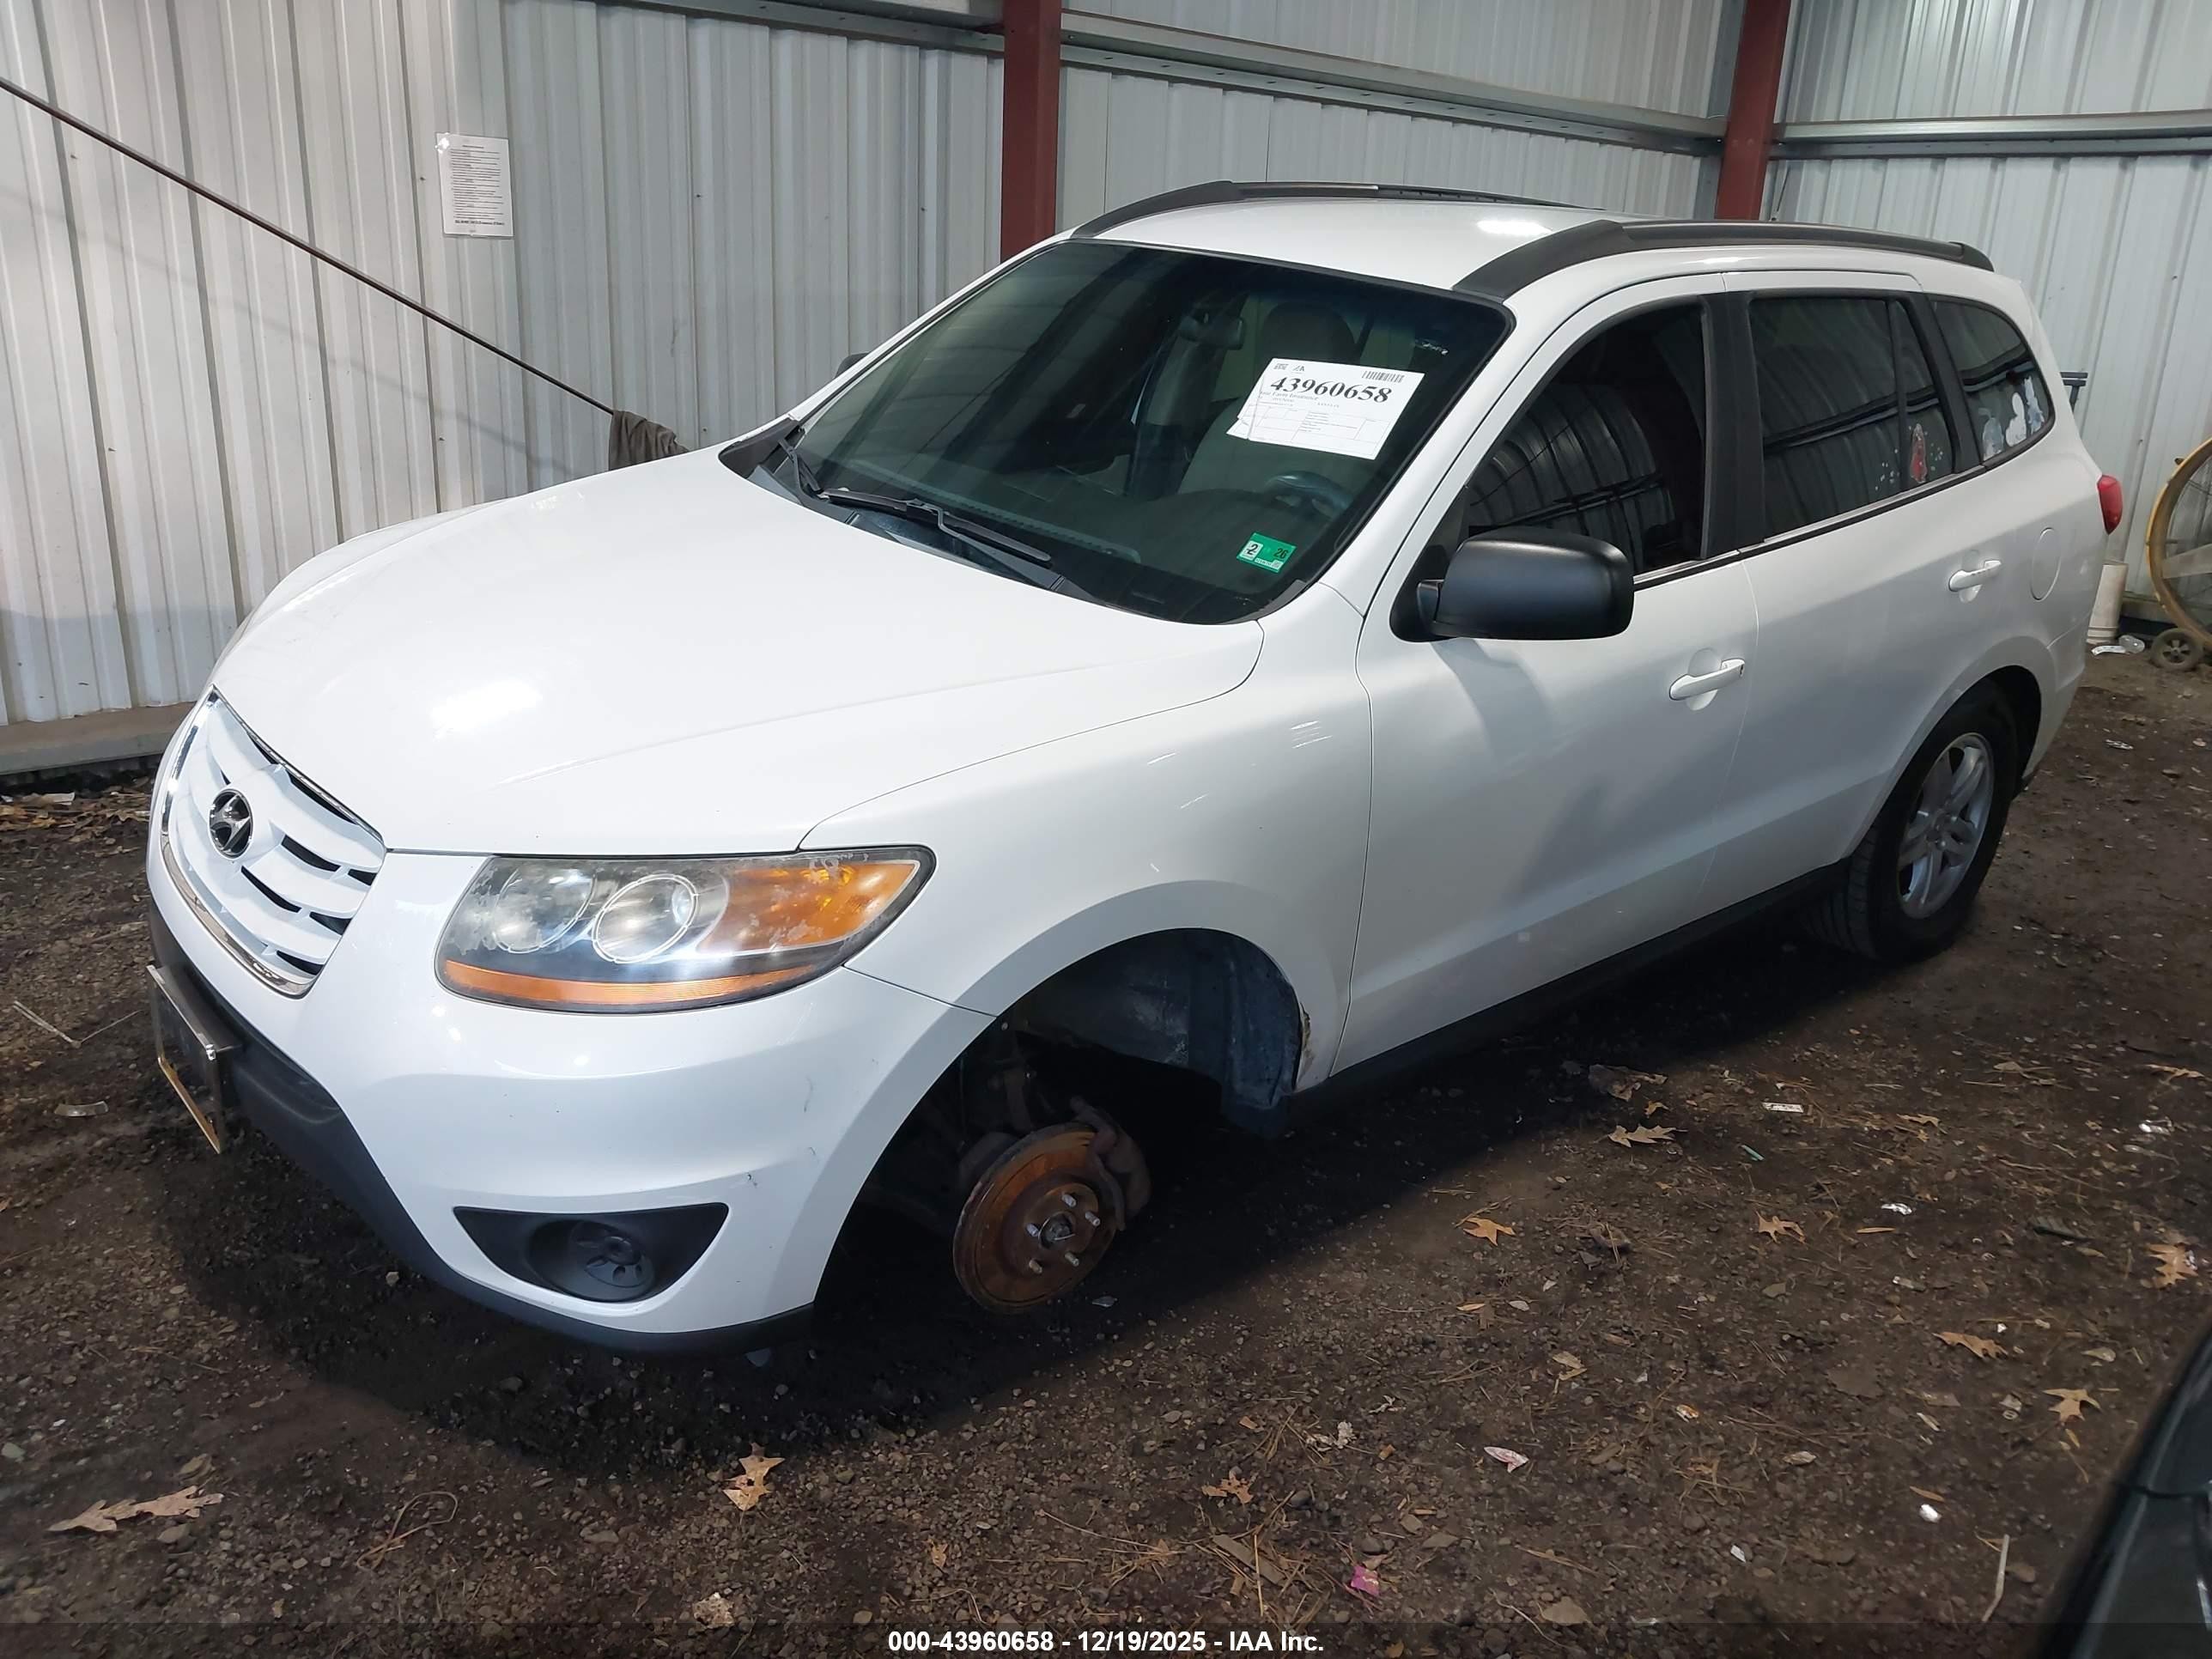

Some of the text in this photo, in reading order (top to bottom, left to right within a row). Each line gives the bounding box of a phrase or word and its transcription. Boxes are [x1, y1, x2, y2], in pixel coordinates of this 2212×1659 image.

[1271, 376, 1393, 404] 43960658
[1247, 544, 1258, 556] 2
[1273, 548, 1289, 559] 26
